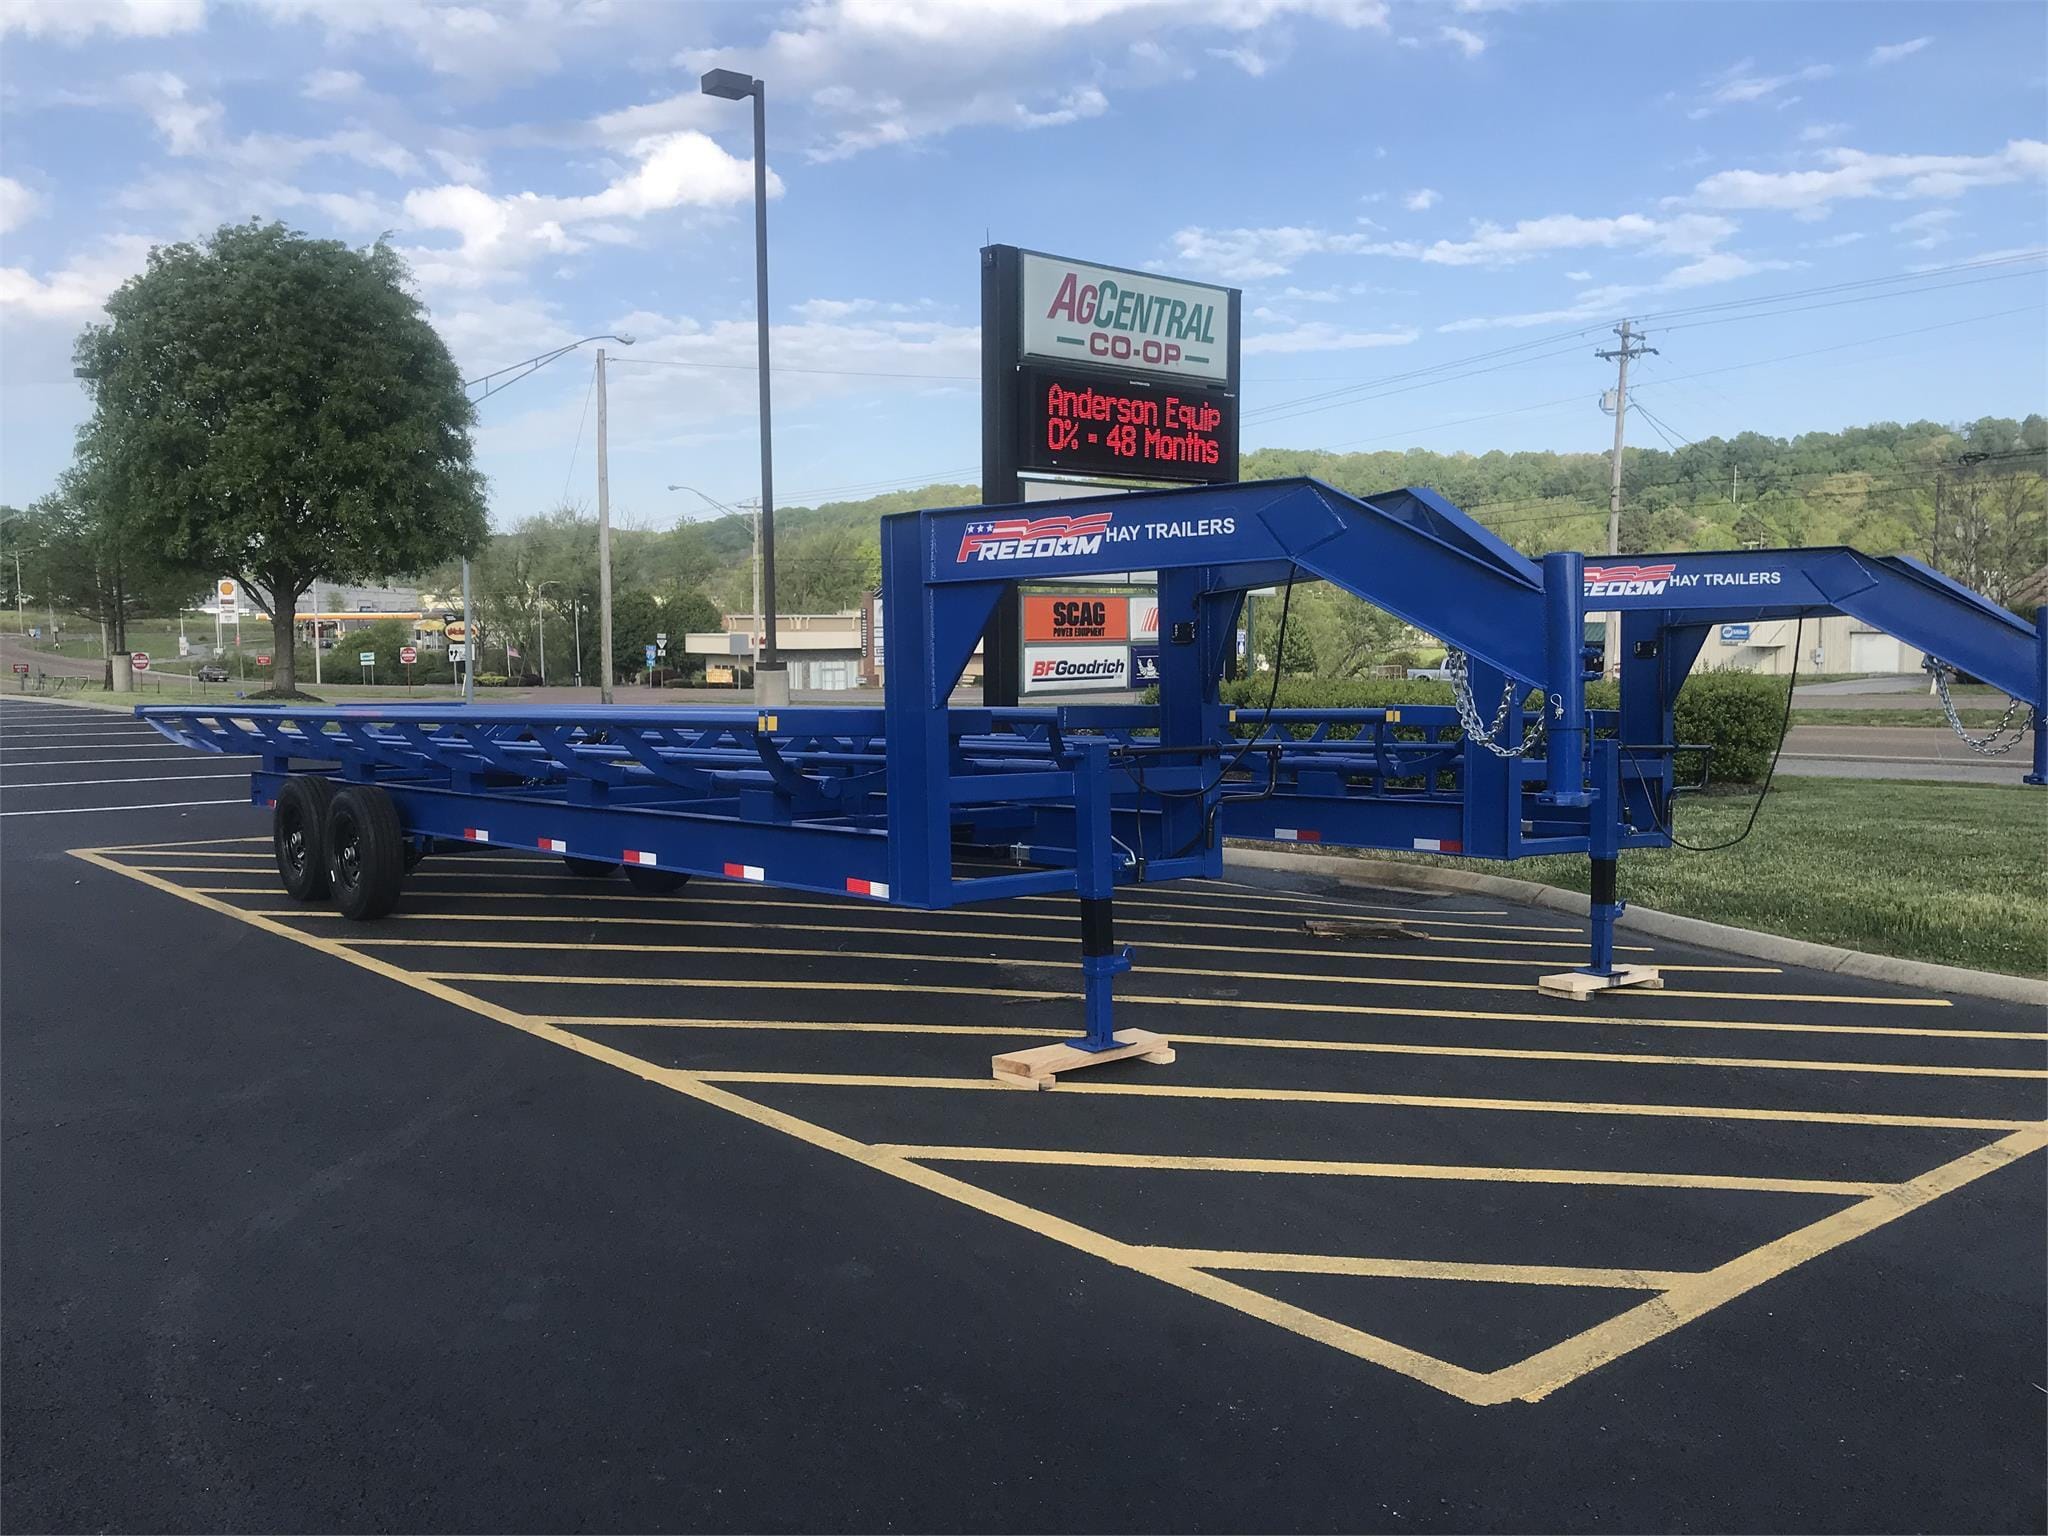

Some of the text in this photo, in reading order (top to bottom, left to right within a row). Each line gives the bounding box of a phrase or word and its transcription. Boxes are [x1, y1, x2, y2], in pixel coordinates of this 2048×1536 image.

[1089, 332, 1181, 365] CO-OP
[1048, 383, 1221, 432] Anderson Equip
[1048, 417, 1079, 450] 0%
[1106, 424, 1137, 457] 48
[1144, 428, 1219, 464] Months
[957, 517, 1235, 562] FREEDOM HAY TRAILERS
[1670, 574, 1700, 587] HAY
[1704, 572, 1781, 586] TRAILERS
[1053, 602, 1105, 626] SCAG
[1053, 627, 1105, 637] POWER EQUIPMENT
[1032, 659, 1125, 676] BFGoodrich
